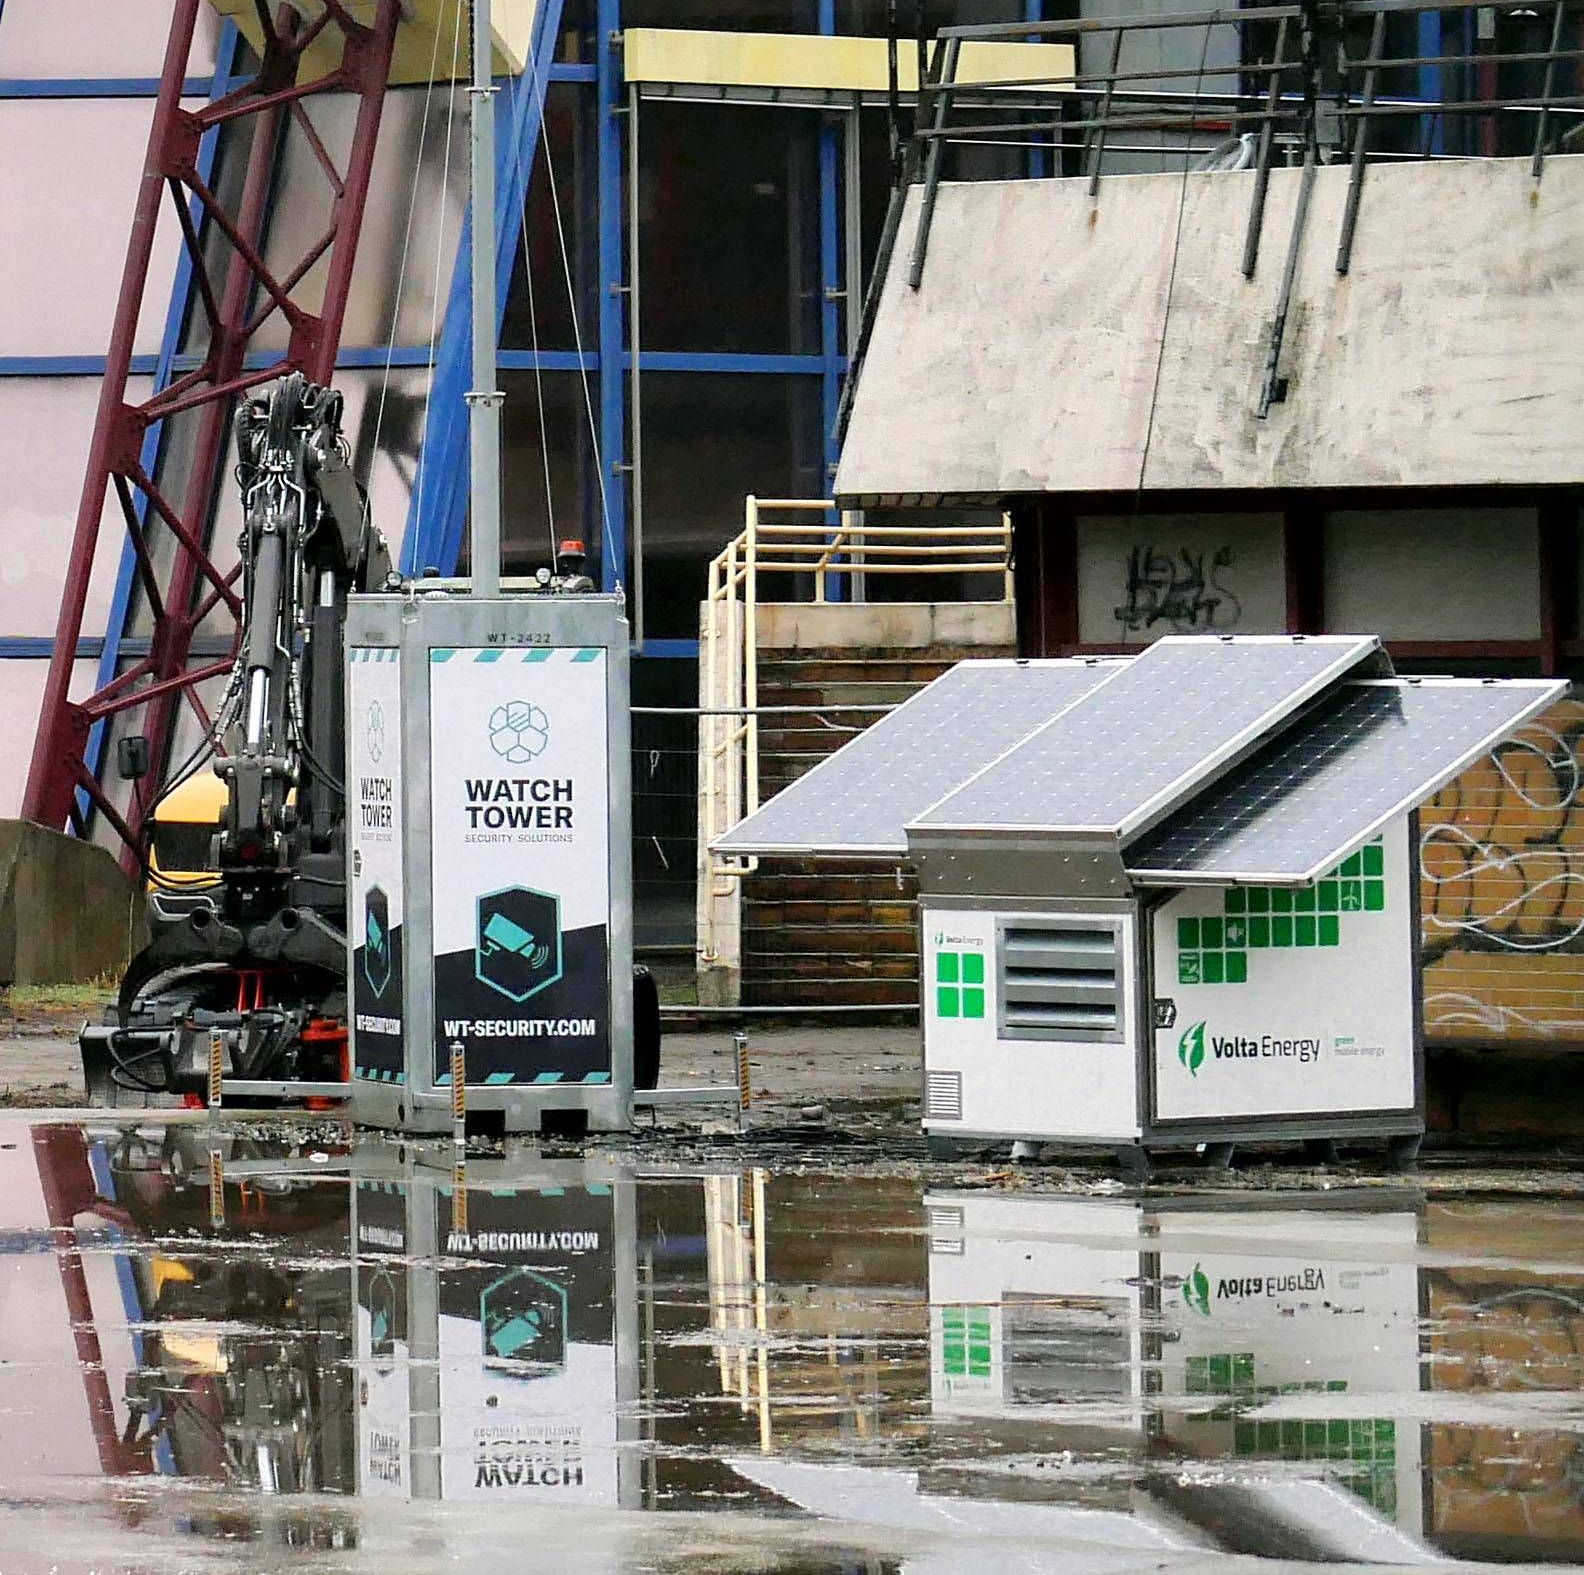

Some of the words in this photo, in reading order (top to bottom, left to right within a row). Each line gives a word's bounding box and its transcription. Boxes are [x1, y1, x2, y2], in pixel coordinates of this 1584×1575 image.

[360, 777, 392, 802] WATCH
[465, 778, 573, 802] WATCH
[360, 803, 392, 829] TOWER
[465, 806, 573, 829] TOWER
[465, 834, 512, 843] SECURITY
[518, 833, 573, 843] SOLUTIONS
[444, 1019, 596, 1037] WT-SECURITY.COM
[1212, 1037, 1258, 1058] Volta
[1262, 1036, 1320, 1063] Energy
